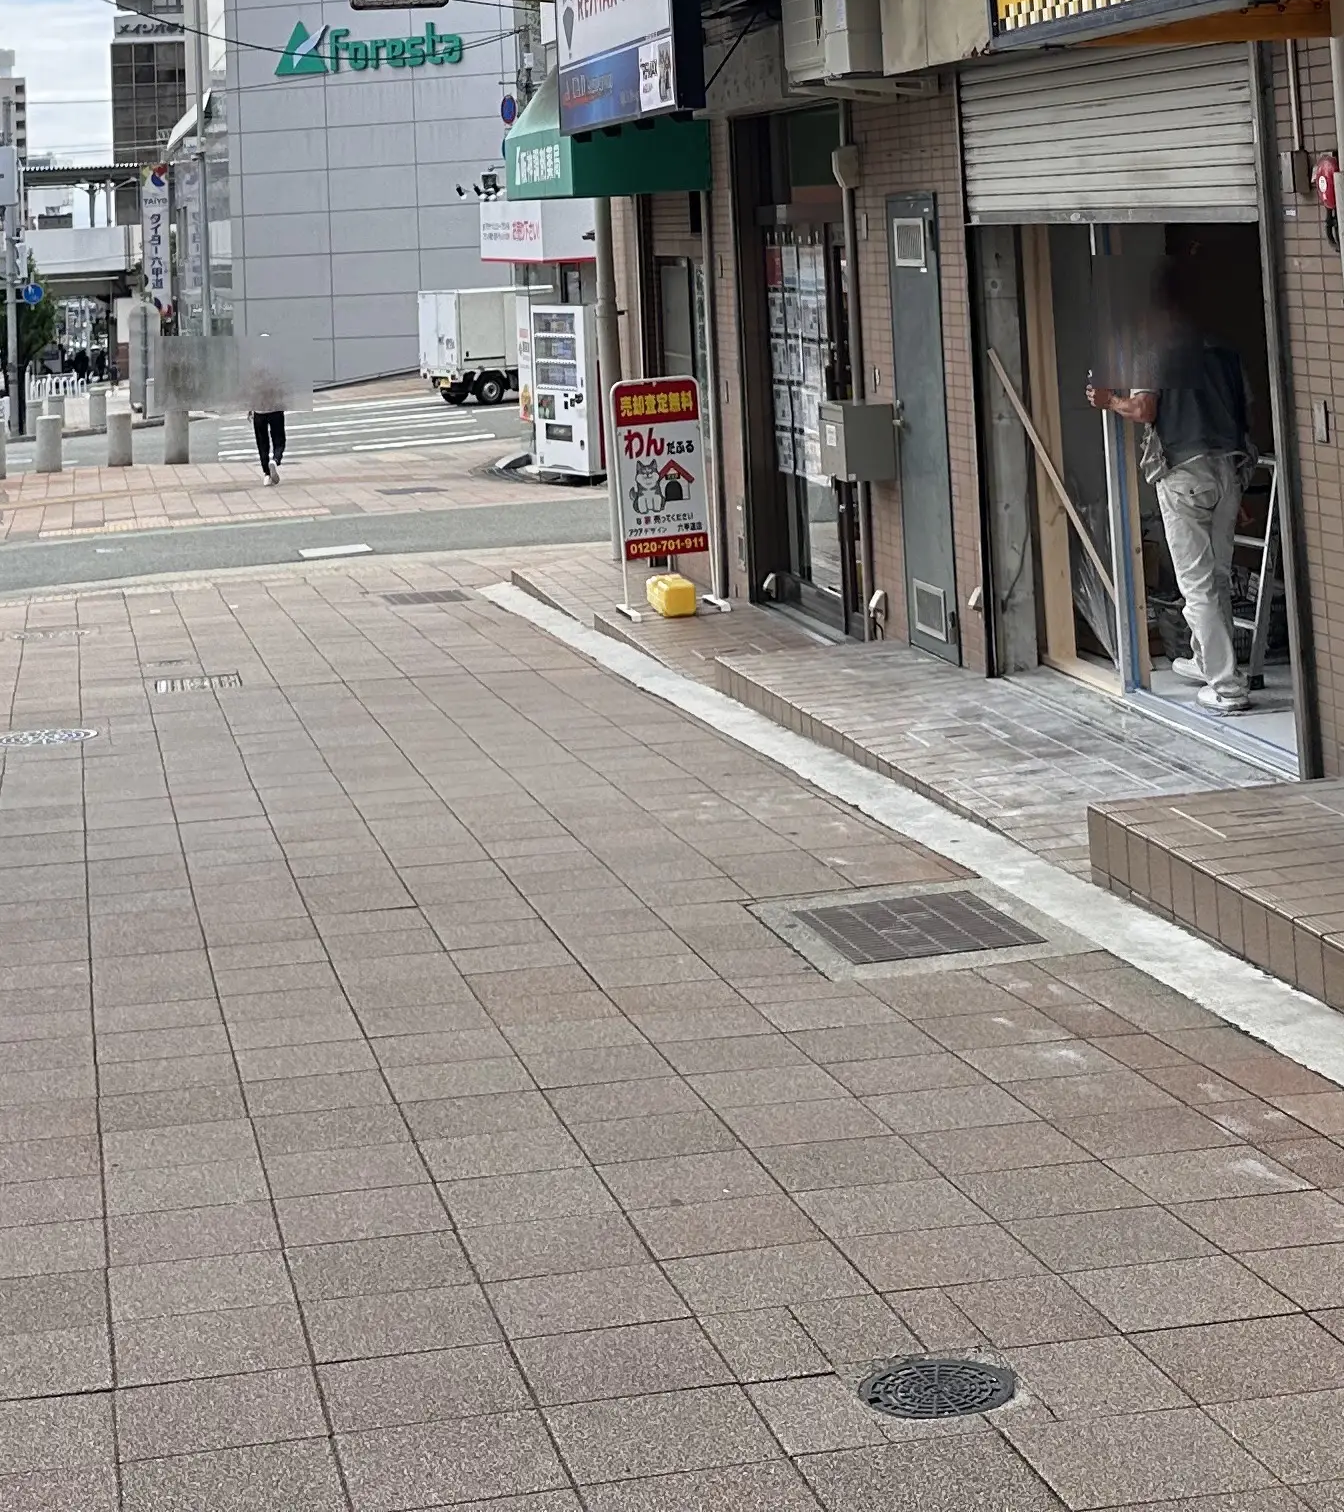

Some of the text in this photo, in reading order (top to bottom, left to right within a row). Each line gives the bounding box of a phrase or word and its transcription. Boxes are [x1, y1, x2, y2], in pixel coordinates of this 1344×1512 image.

[620, 390, 693, 417] 売却査定無料
